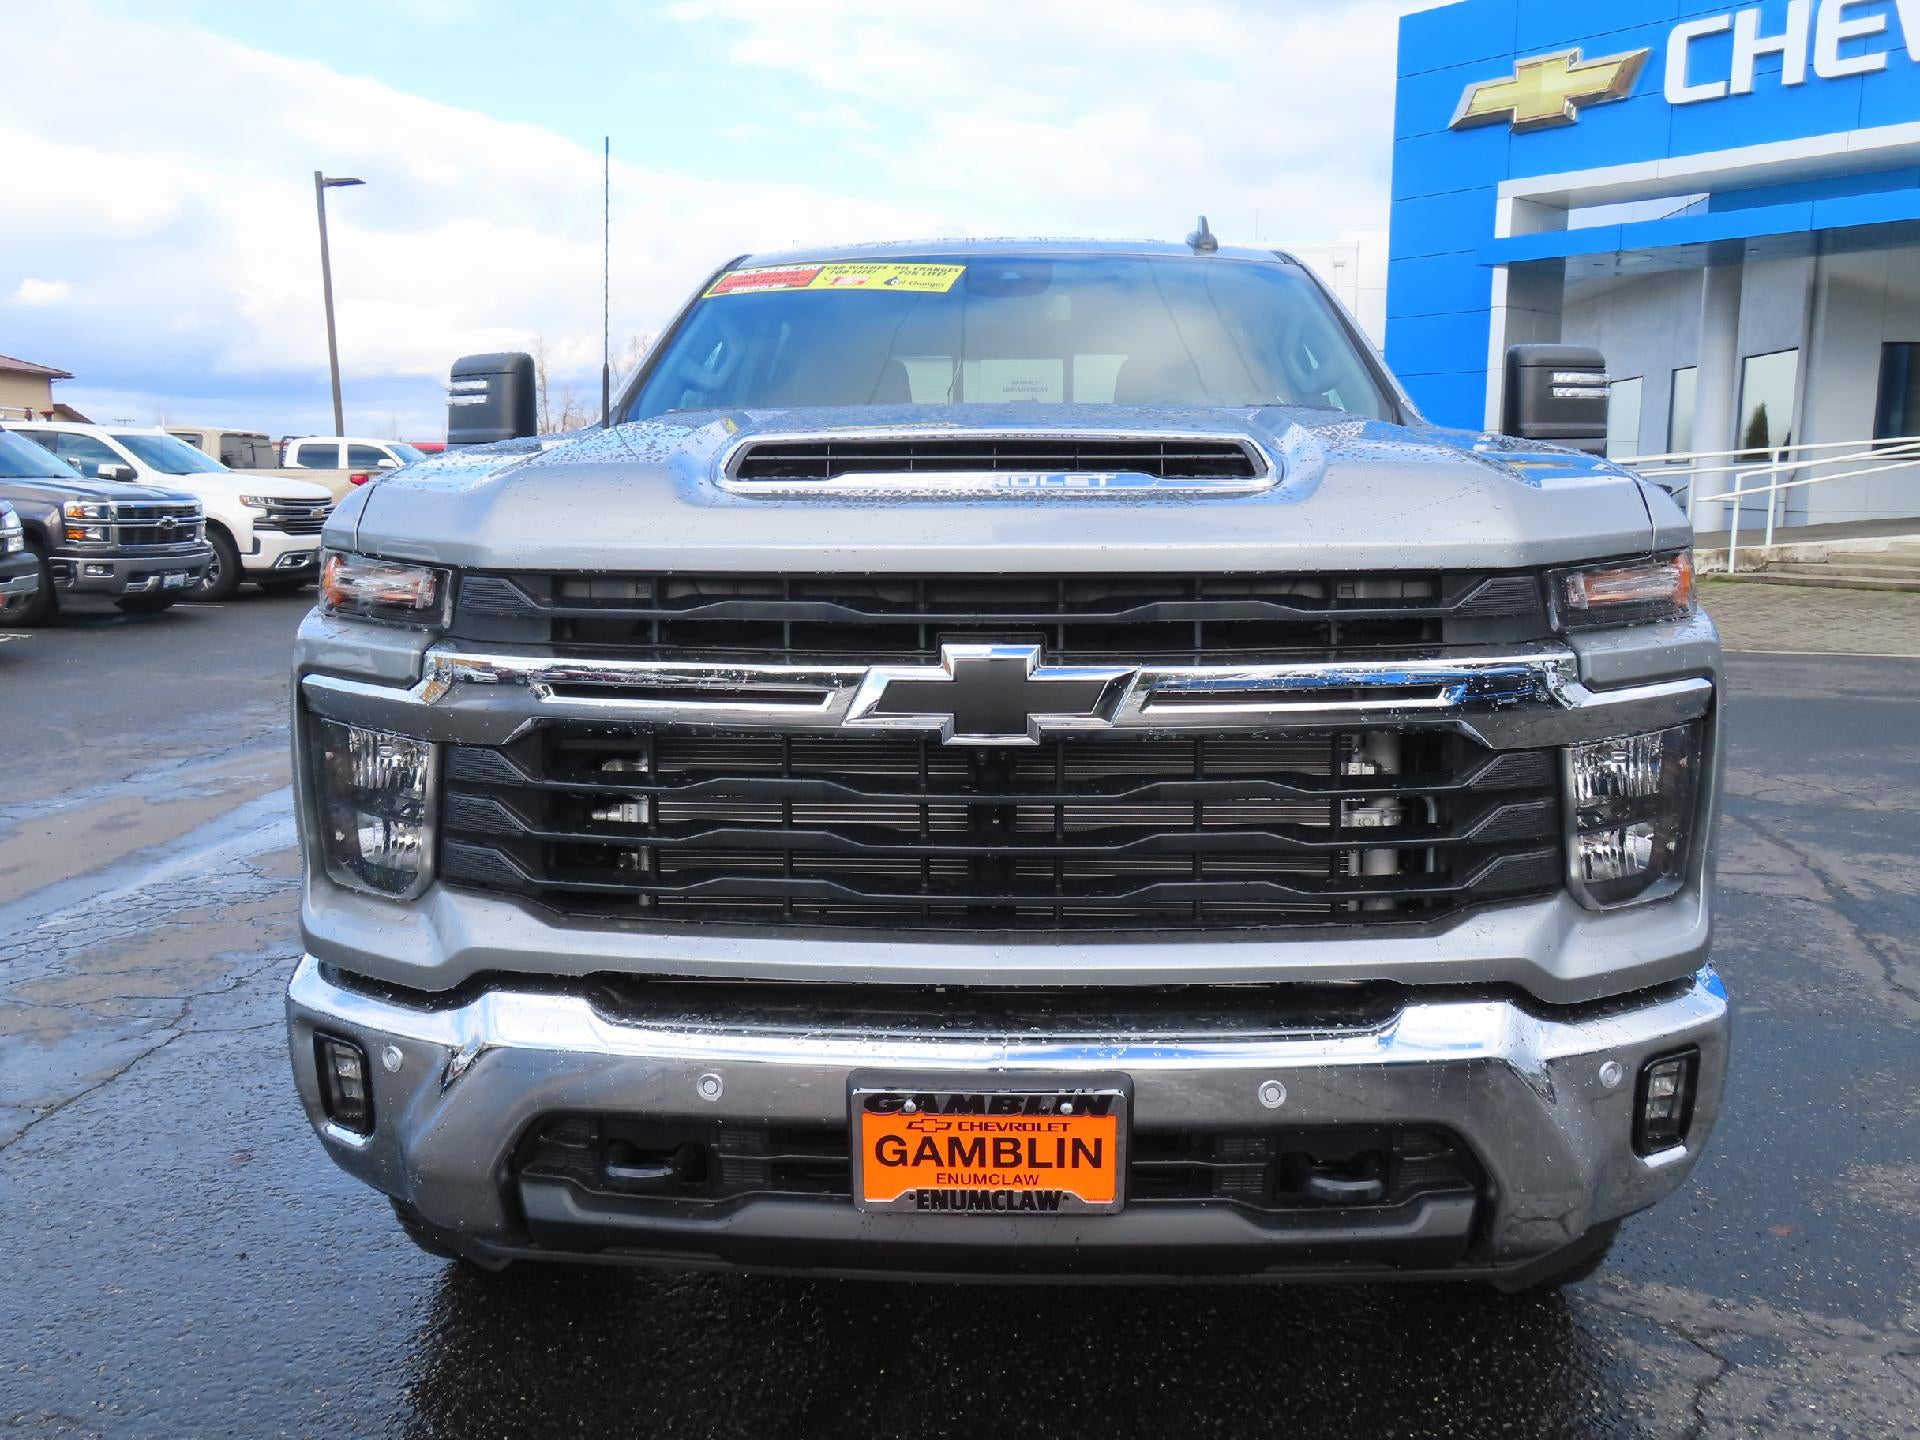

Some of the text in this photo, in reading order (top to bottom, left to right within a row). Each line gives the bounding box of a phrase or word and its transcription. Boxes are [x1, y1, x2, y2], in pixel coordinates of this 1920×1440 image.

[957, 1121, 1071, 1132] CHEVROLET
[874, 1135, 1102, 1169] GAMBLIN
[936, 1173, 1040, 1186] ENUMCLAW
[916, 1190, 1063, 1211] ENUMCLAW
